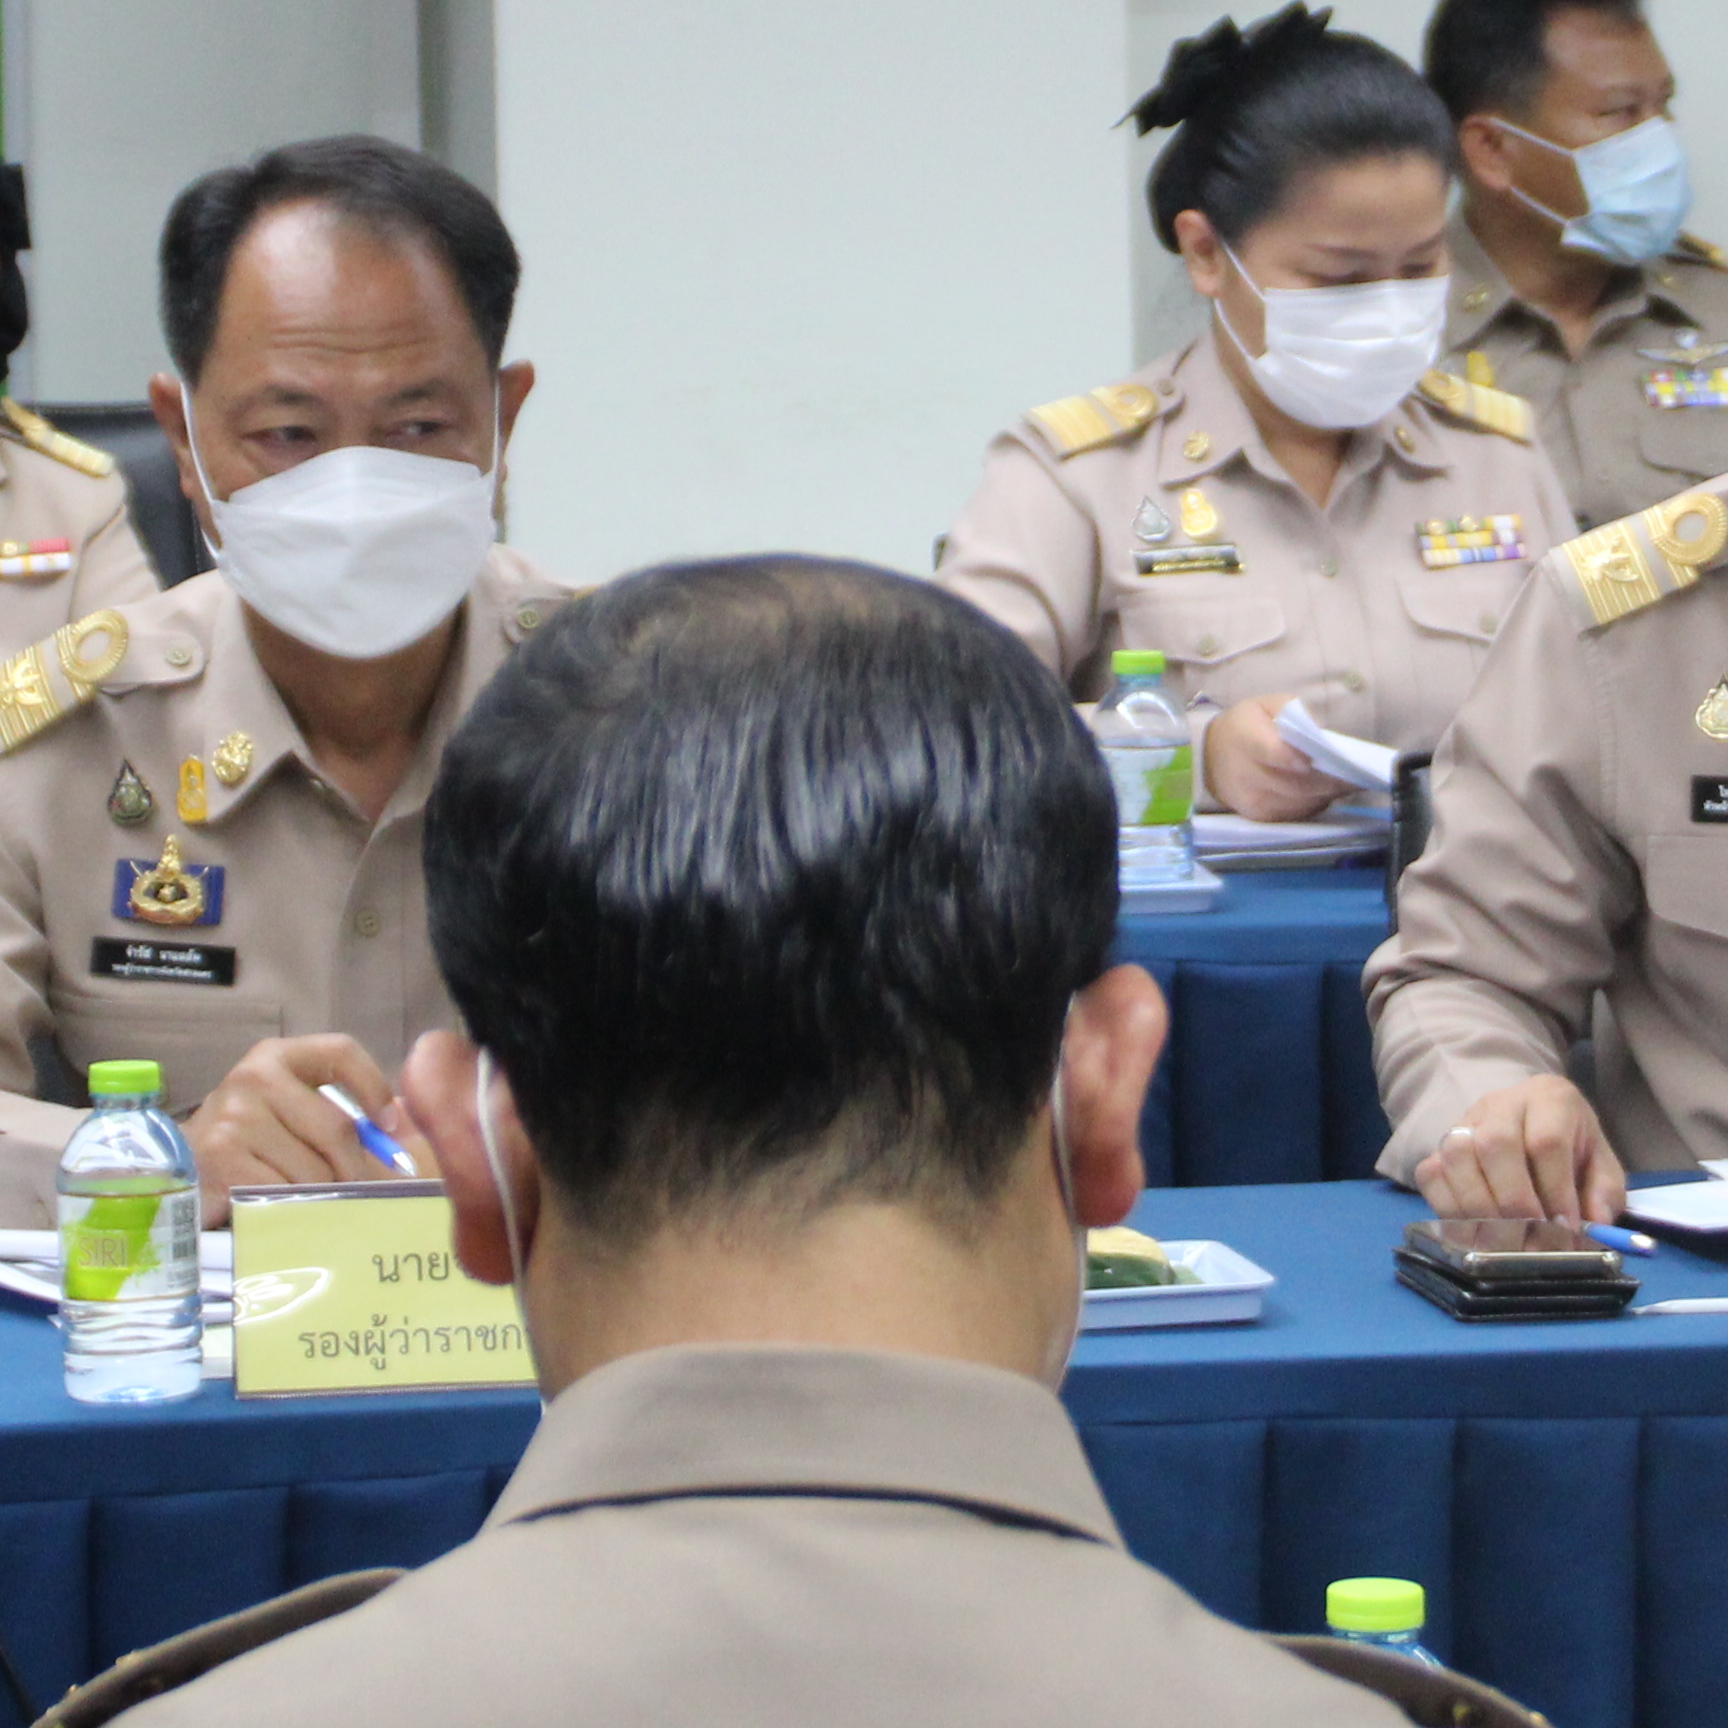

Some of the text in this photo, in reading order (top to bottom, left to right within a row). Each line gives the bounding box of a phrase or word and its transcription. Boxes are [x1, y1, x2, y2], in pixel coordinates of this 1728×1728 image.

[77, 1236, 127, 1268] SIRI
[371, 1249, 462, 1284] นาย
[298, 1313, 531, 1371] รองผู้ว่าราชก
